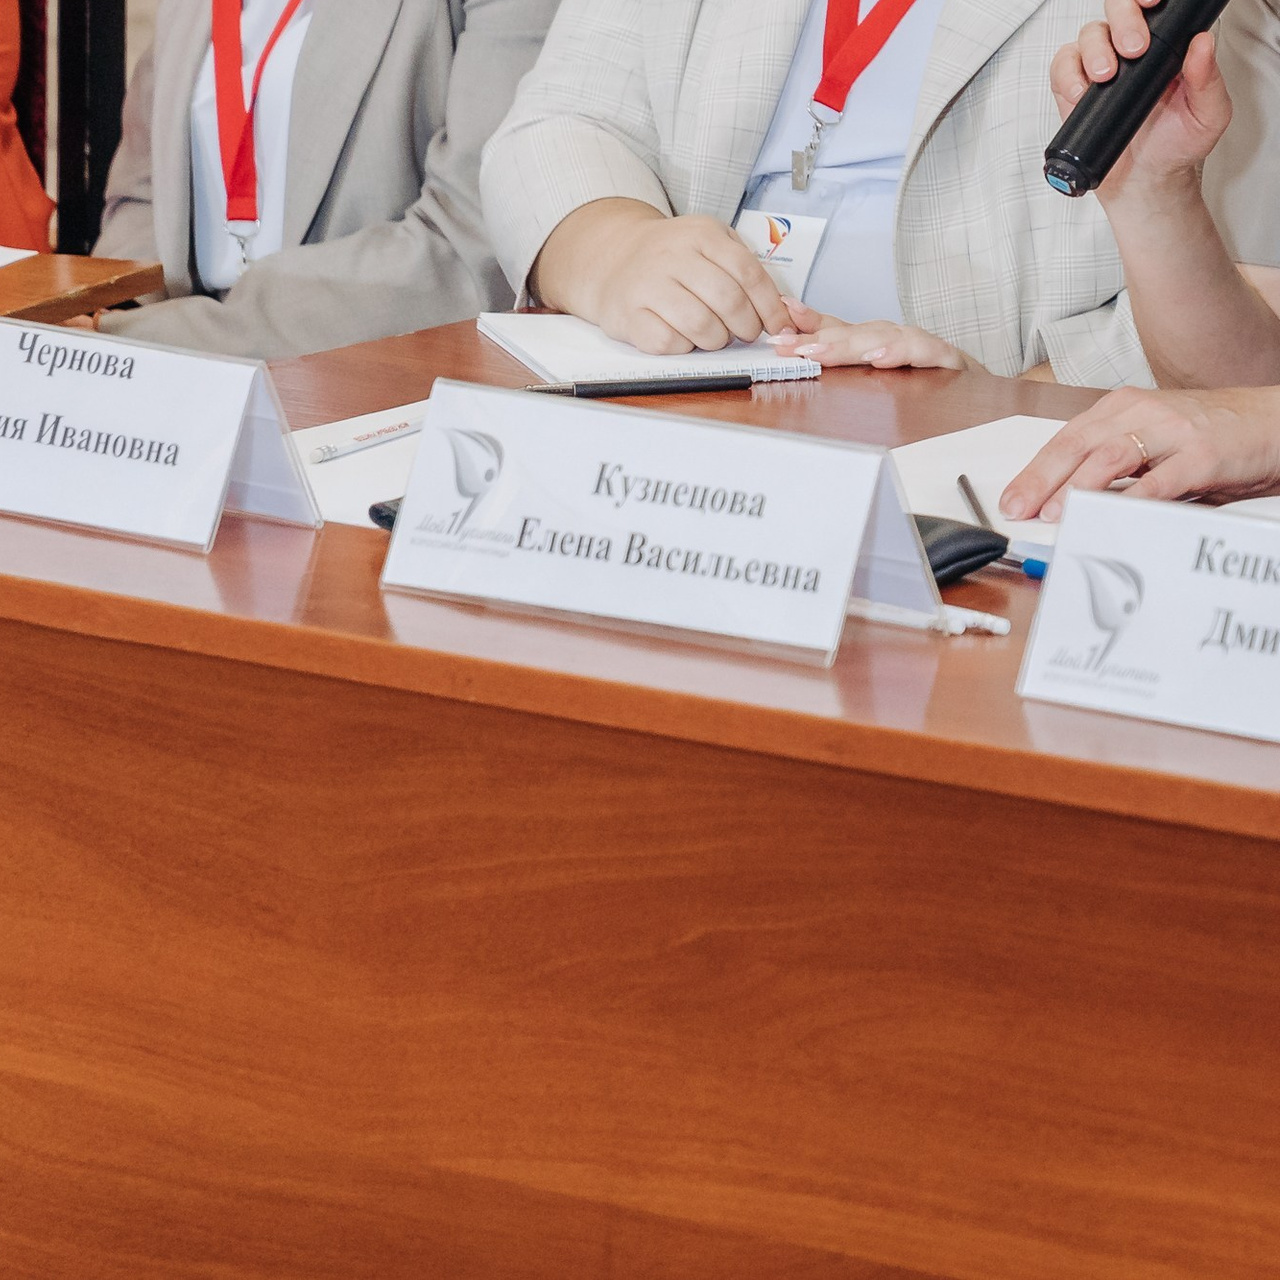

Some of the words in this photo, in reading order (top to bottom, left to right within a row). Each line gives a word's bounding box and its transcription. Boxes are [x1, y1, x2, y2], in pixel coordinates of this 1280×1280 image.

[18, 331, 135, 380] Чернова
[34, 412, 180, 468] Ивановна
[592, 461, 766, 519] Кузнецова
[515, 517, 611, 562] Елена
[622, 533, 821, 593] Васильевна
